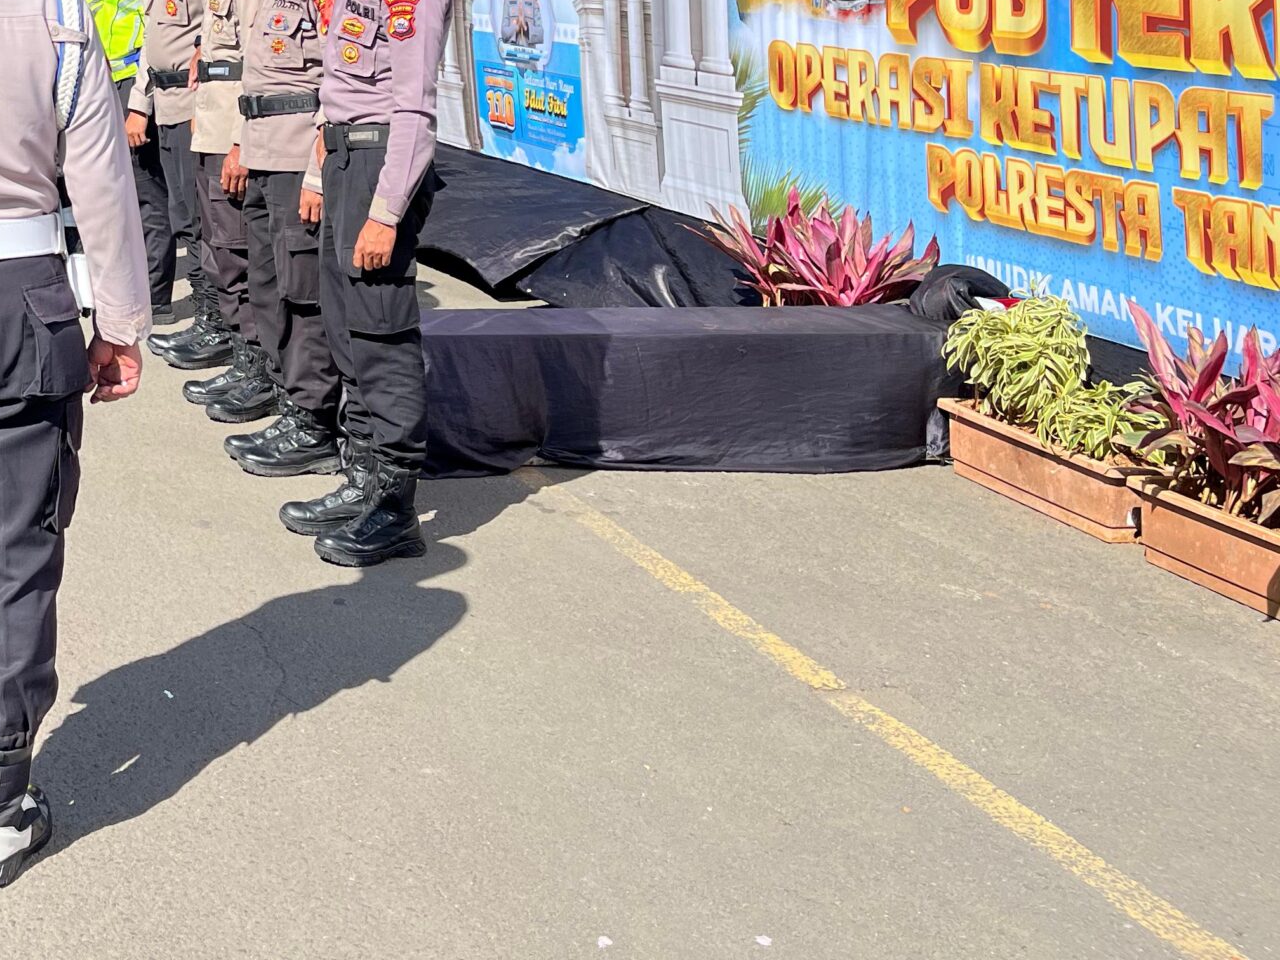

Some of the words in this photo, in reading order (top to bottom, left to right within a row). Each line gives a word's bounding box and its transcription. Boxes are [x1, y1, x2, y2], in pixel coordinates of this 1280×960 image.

[281, 98, 313, 110] POLRI
[486, 89, 515, 131] 110
[768, 39, 973, 139] OPERASI
[979, 63, 1274, 191] KETUPAT
[926, 143, 1163, 262] POLRESTA
